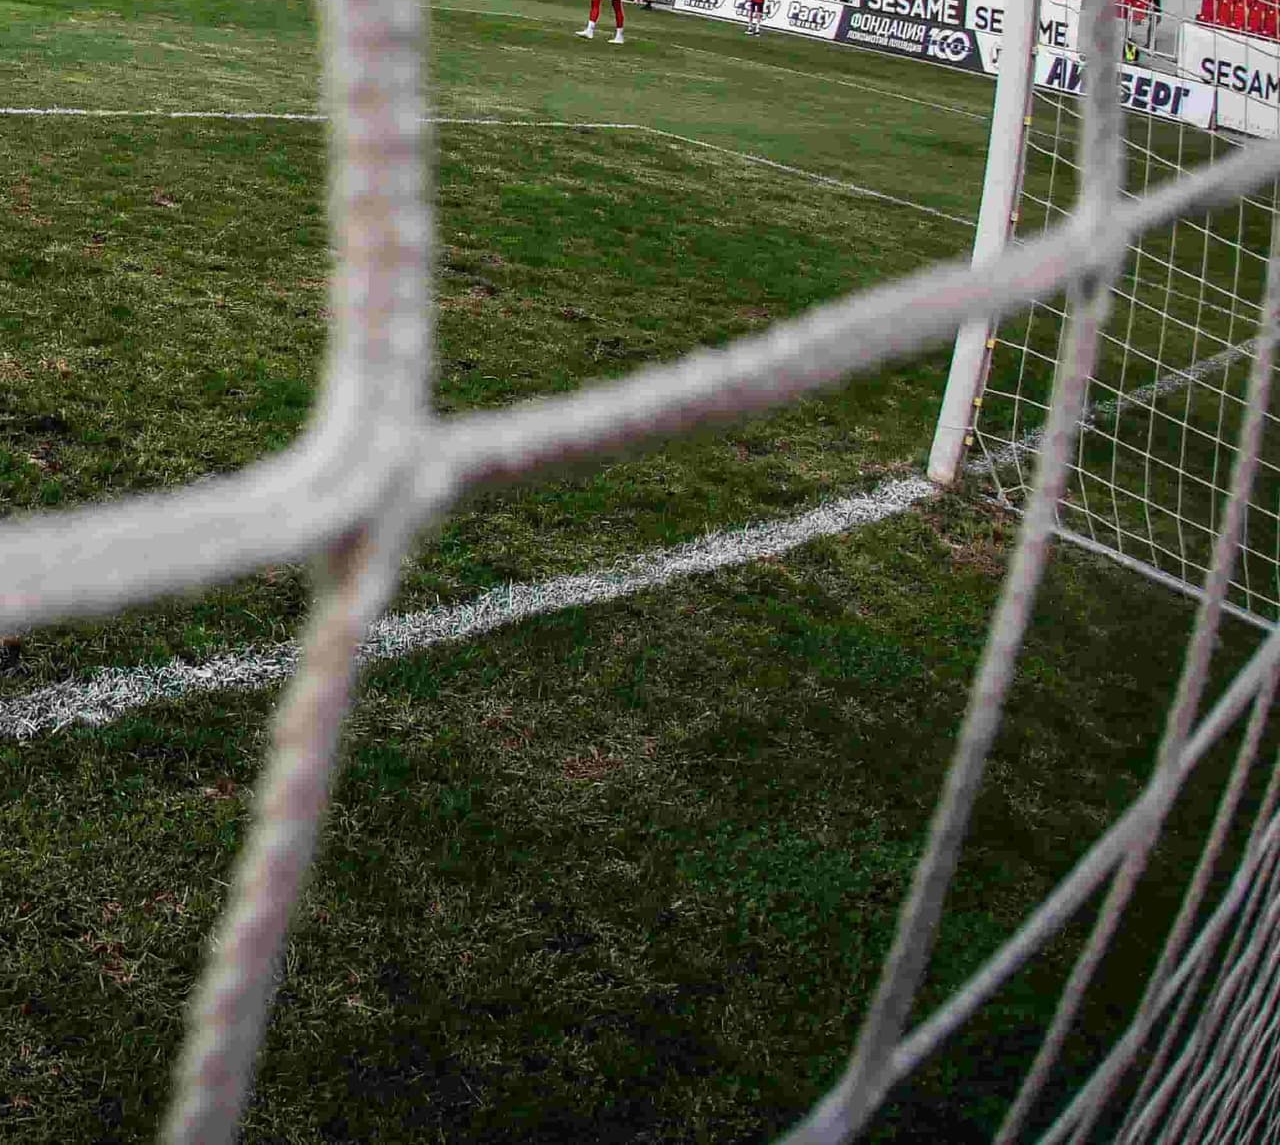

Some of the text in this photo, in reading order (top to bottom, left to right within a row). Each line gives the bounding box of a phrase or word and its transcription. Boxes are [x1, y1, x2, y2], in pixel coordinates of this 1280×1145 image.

[787, 2, 836, 29] Party
[850, 13, 927, 45] ФОНДАЦИЯ
[1200, 57, 1280, 101] SESAM
